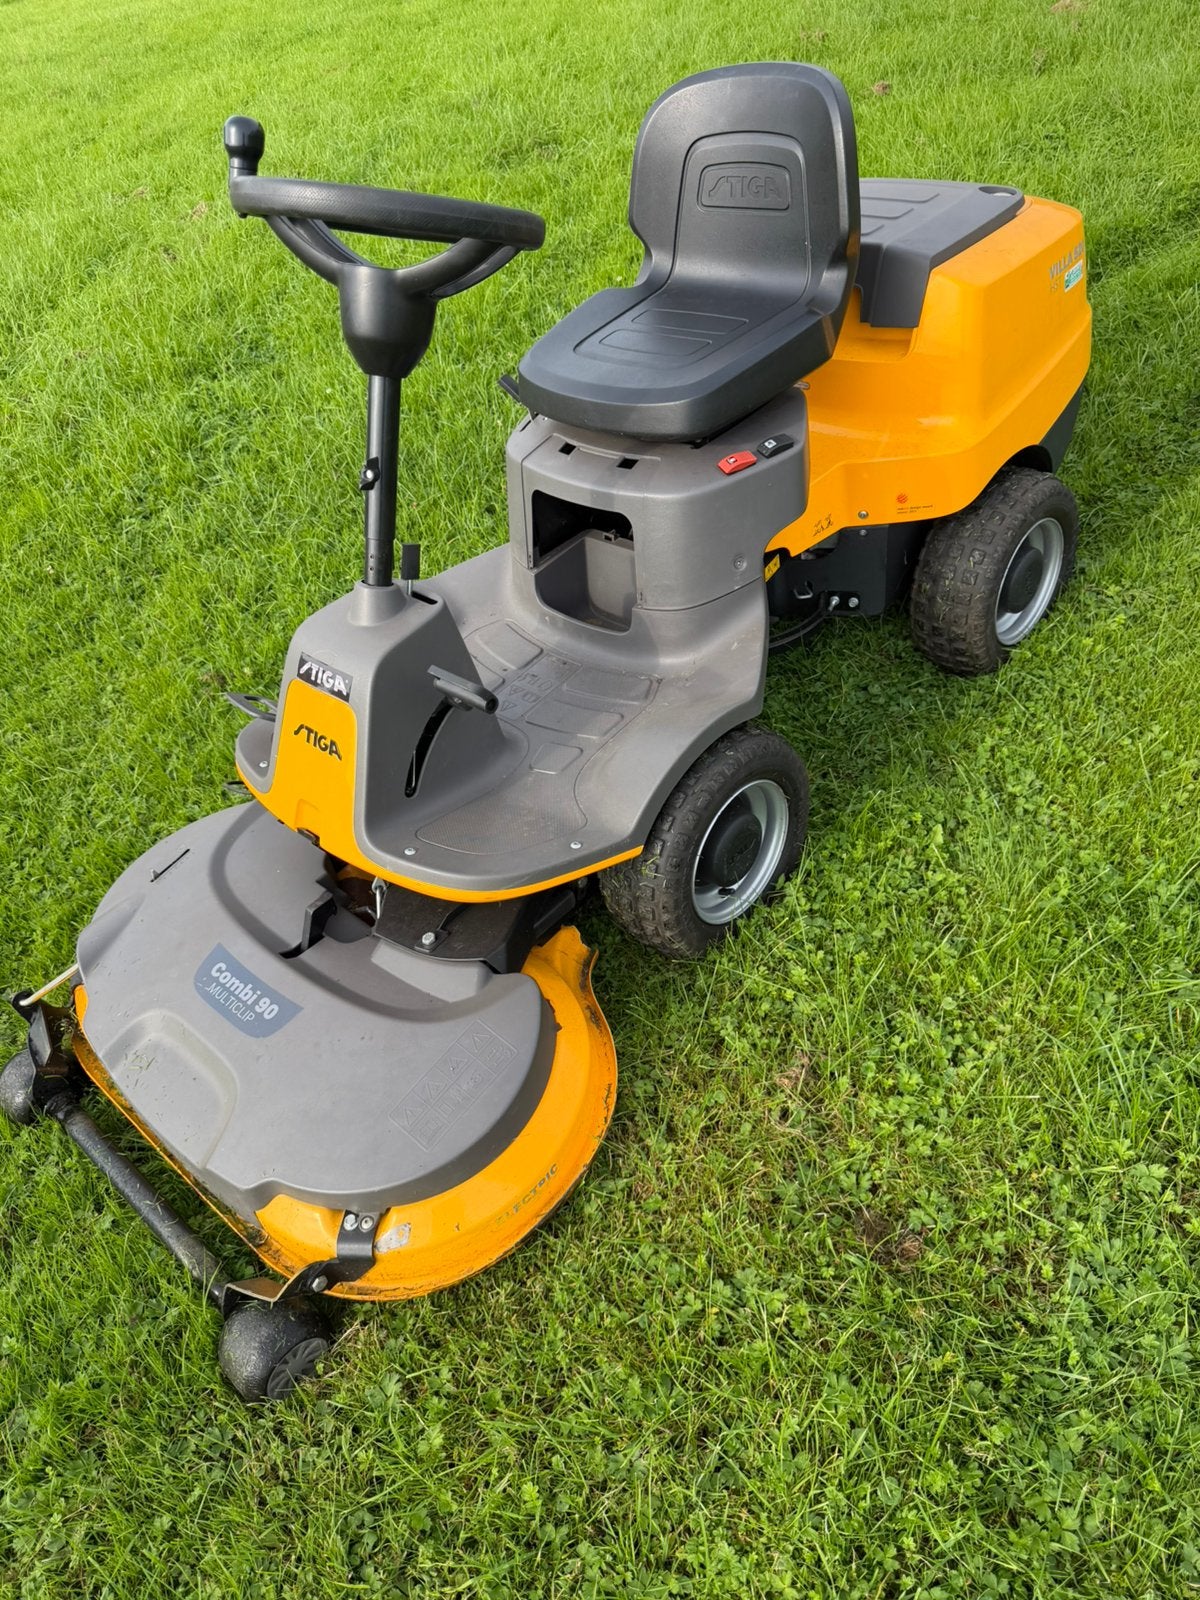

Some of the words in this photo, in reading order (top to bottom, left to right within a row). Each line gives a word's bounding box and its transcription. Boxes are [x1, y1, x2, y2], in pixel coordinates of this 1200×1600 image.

[707, 175, 782, 200] STIGA
[1048, 251, 1073, 280] VILLA
[299, 661, 348, 696] STIGA
[293, 723, 343, 762] STIGA
[207, 982, 256, 1023] MULTICLIP
[210, 961, 262, 1006] Combi
[254, 996, 281, 1021] 90
